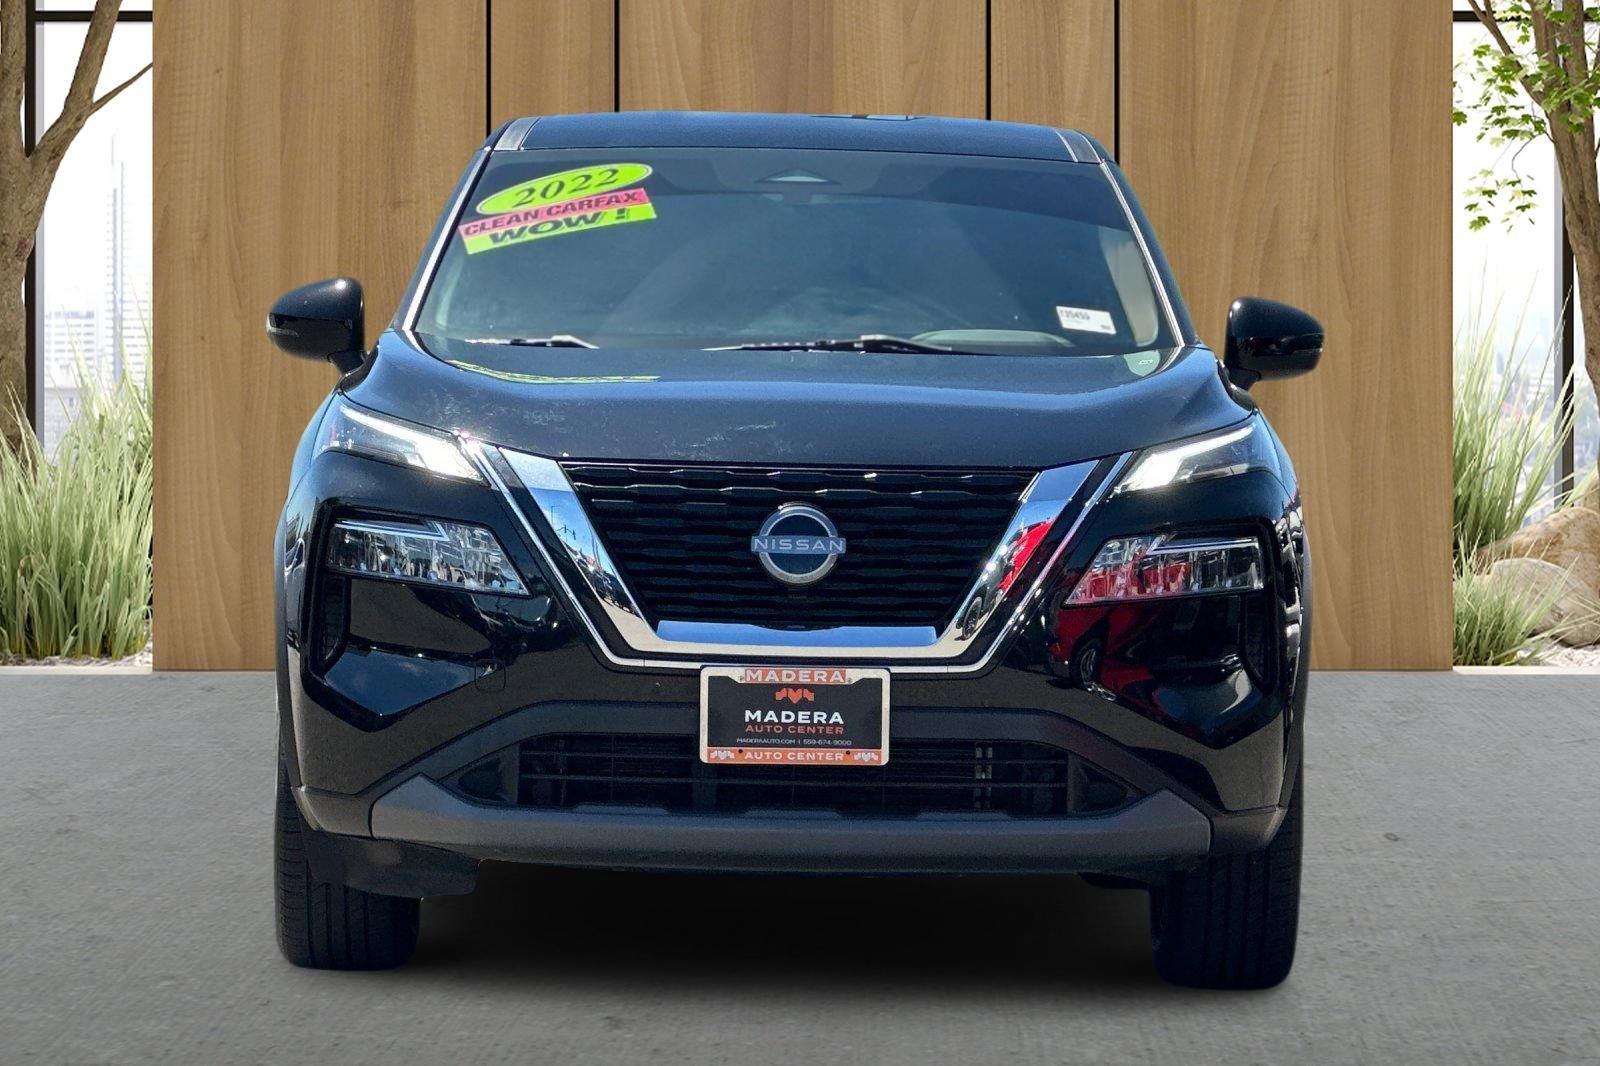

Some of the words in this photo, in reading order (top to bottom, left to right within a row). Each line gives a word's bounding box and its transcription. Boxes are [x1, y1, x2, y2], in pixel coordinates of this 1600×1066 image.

[512, 168, 619, 208] 2022
[464, 209, 540, 236] CLEAN
[546, 191, 638, 215] CARFAX
[754, 538, 843, 551] NISSAN
[746, 669, 845, 683] MADERA
[744, 709, 844, 724] MADERA
[745, 724, 783, 734] AUTO
[787, 725, 844, 735] CENTER
[744, 751, 783, 760] AUTO
[787, 752, 844, 761] CENTER
